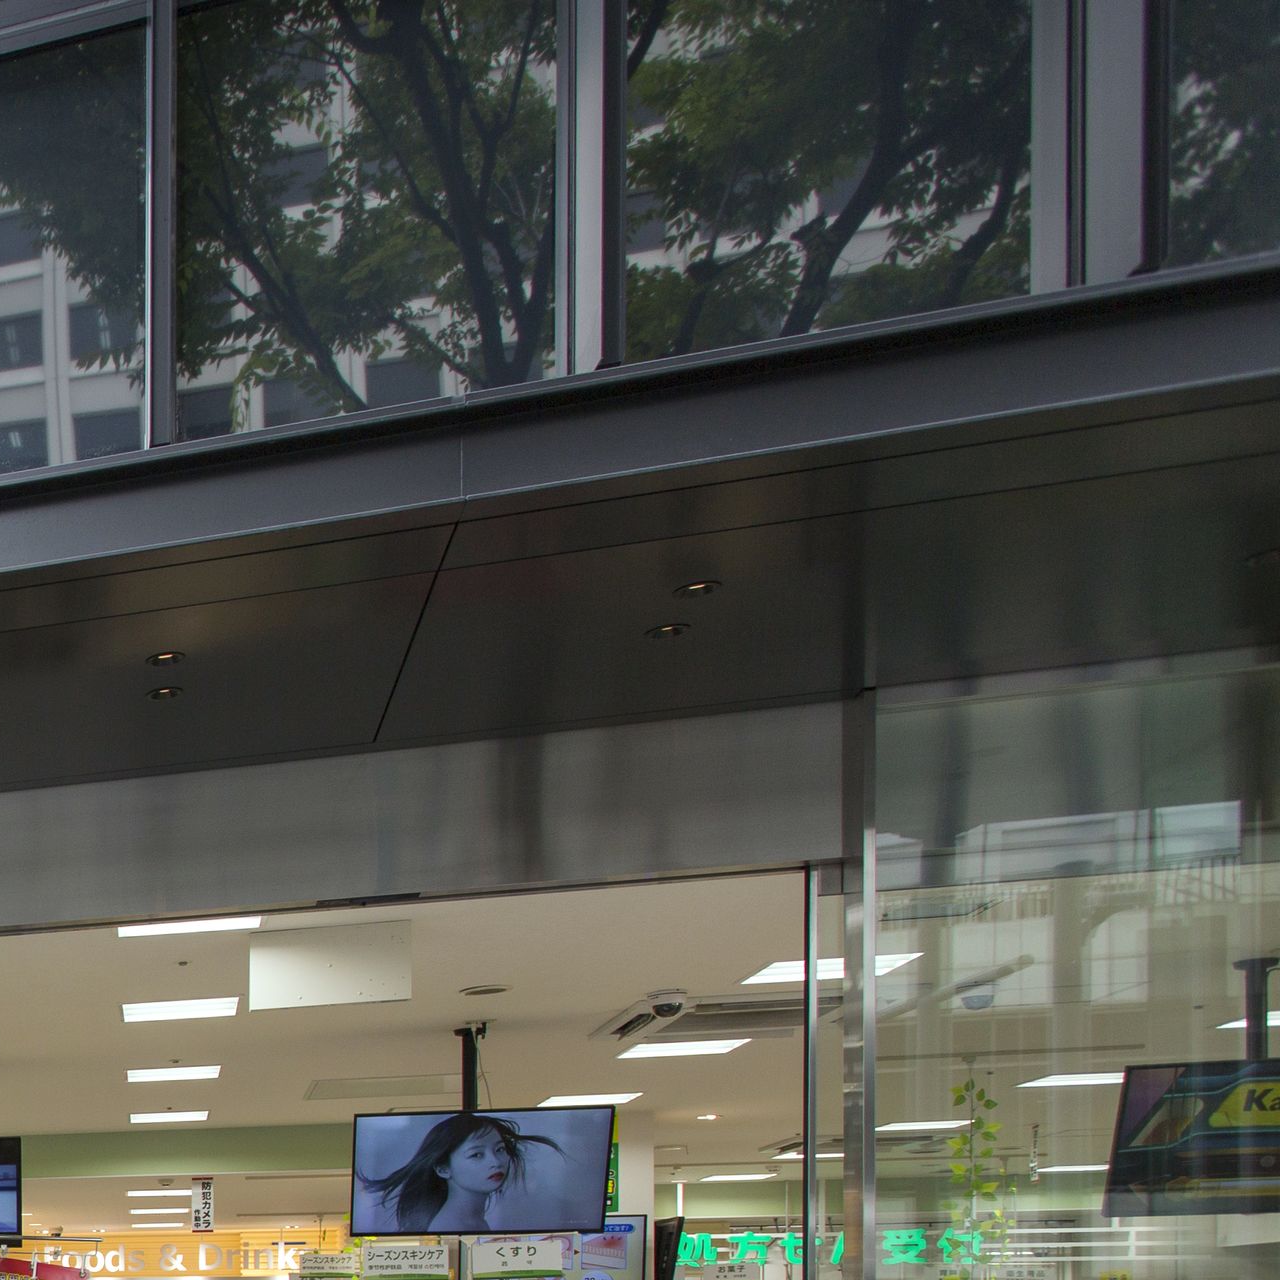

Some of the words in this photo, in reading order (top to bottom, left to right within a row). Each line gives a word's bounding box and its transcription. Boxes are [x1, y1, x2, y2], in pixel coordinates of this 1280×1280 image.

[201, 1181, 212, 1229] 防犯カメラ
[193, 1209, 202, 1229] 作動中
[44, 1245, 145, 1272] Foods
[160, 1243, 187, 1272] &
[367, 1249, 444, 1262] シーズンスキンケア
[496, 1245, 537, 1258] くすり
[302, 1256, 352, 1265] シーズンスキンケア
[717, 1265, 745, 1273] お菓子
